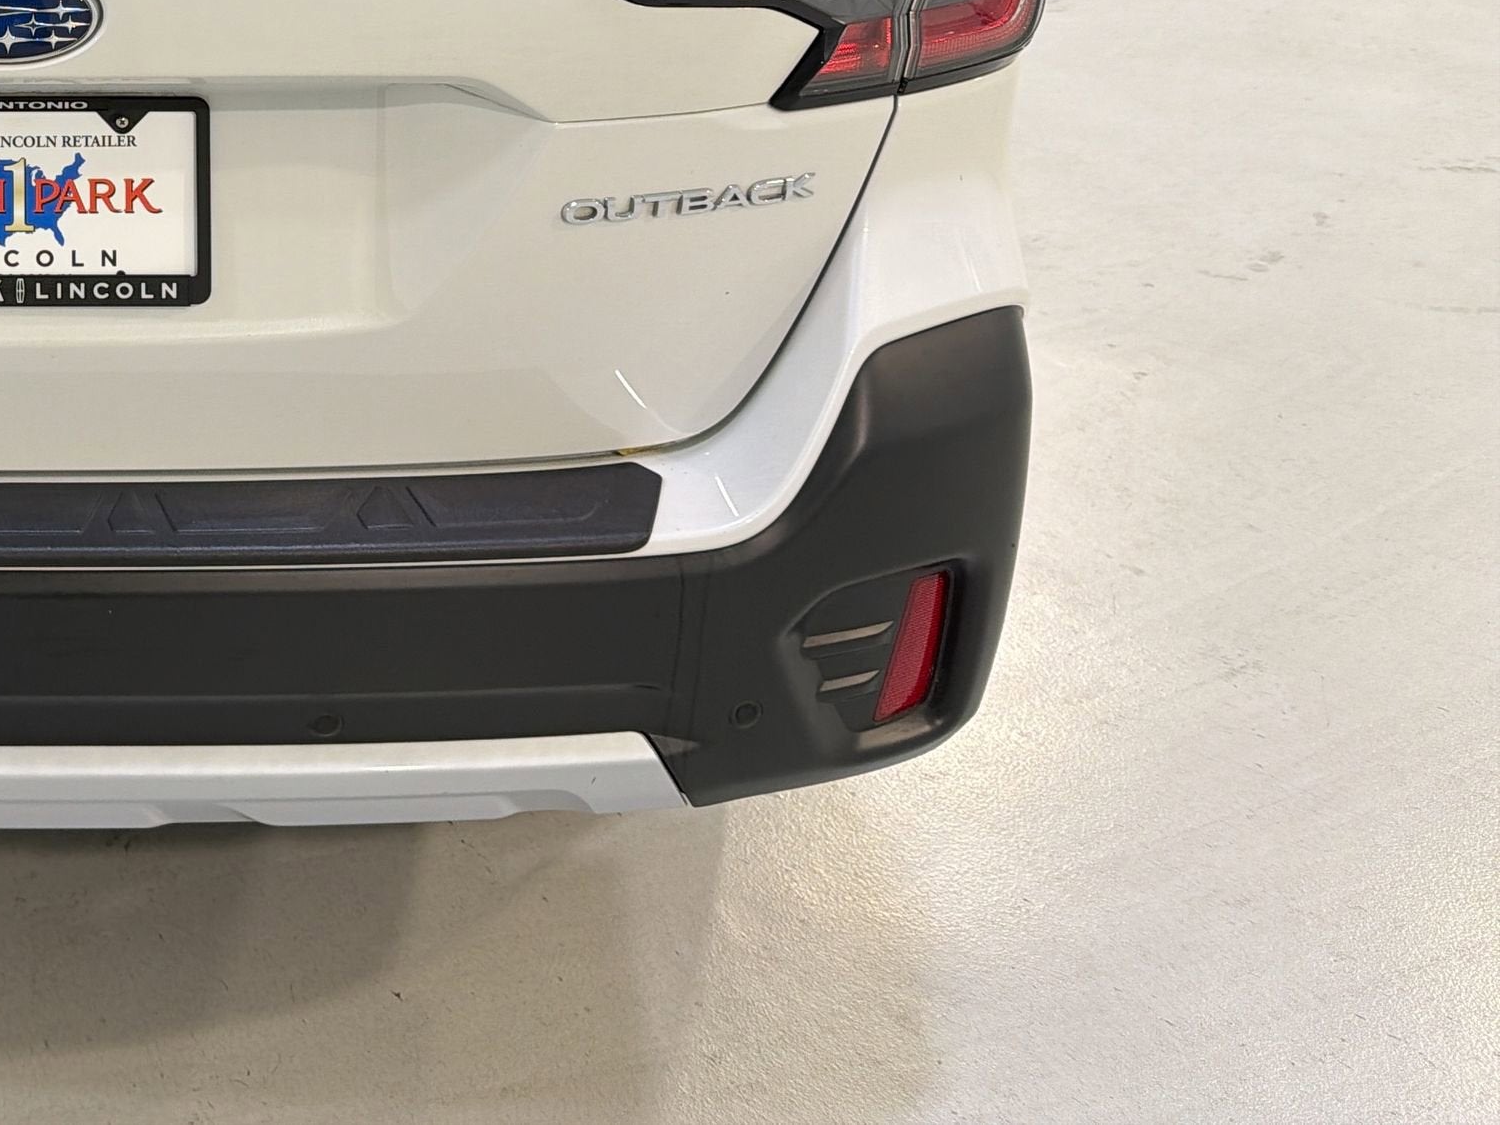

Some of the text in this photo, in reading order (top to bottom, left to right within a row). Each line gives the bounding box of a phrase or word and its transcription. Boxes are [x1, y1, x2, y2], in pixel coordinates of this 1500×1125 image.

[61, 135, 137, 149] RETAILER
[33, 178, 163, 214] PARK
[561, 172, 815, 225] OUTBACK
[35, 282, 177, 299] LINCOLN
